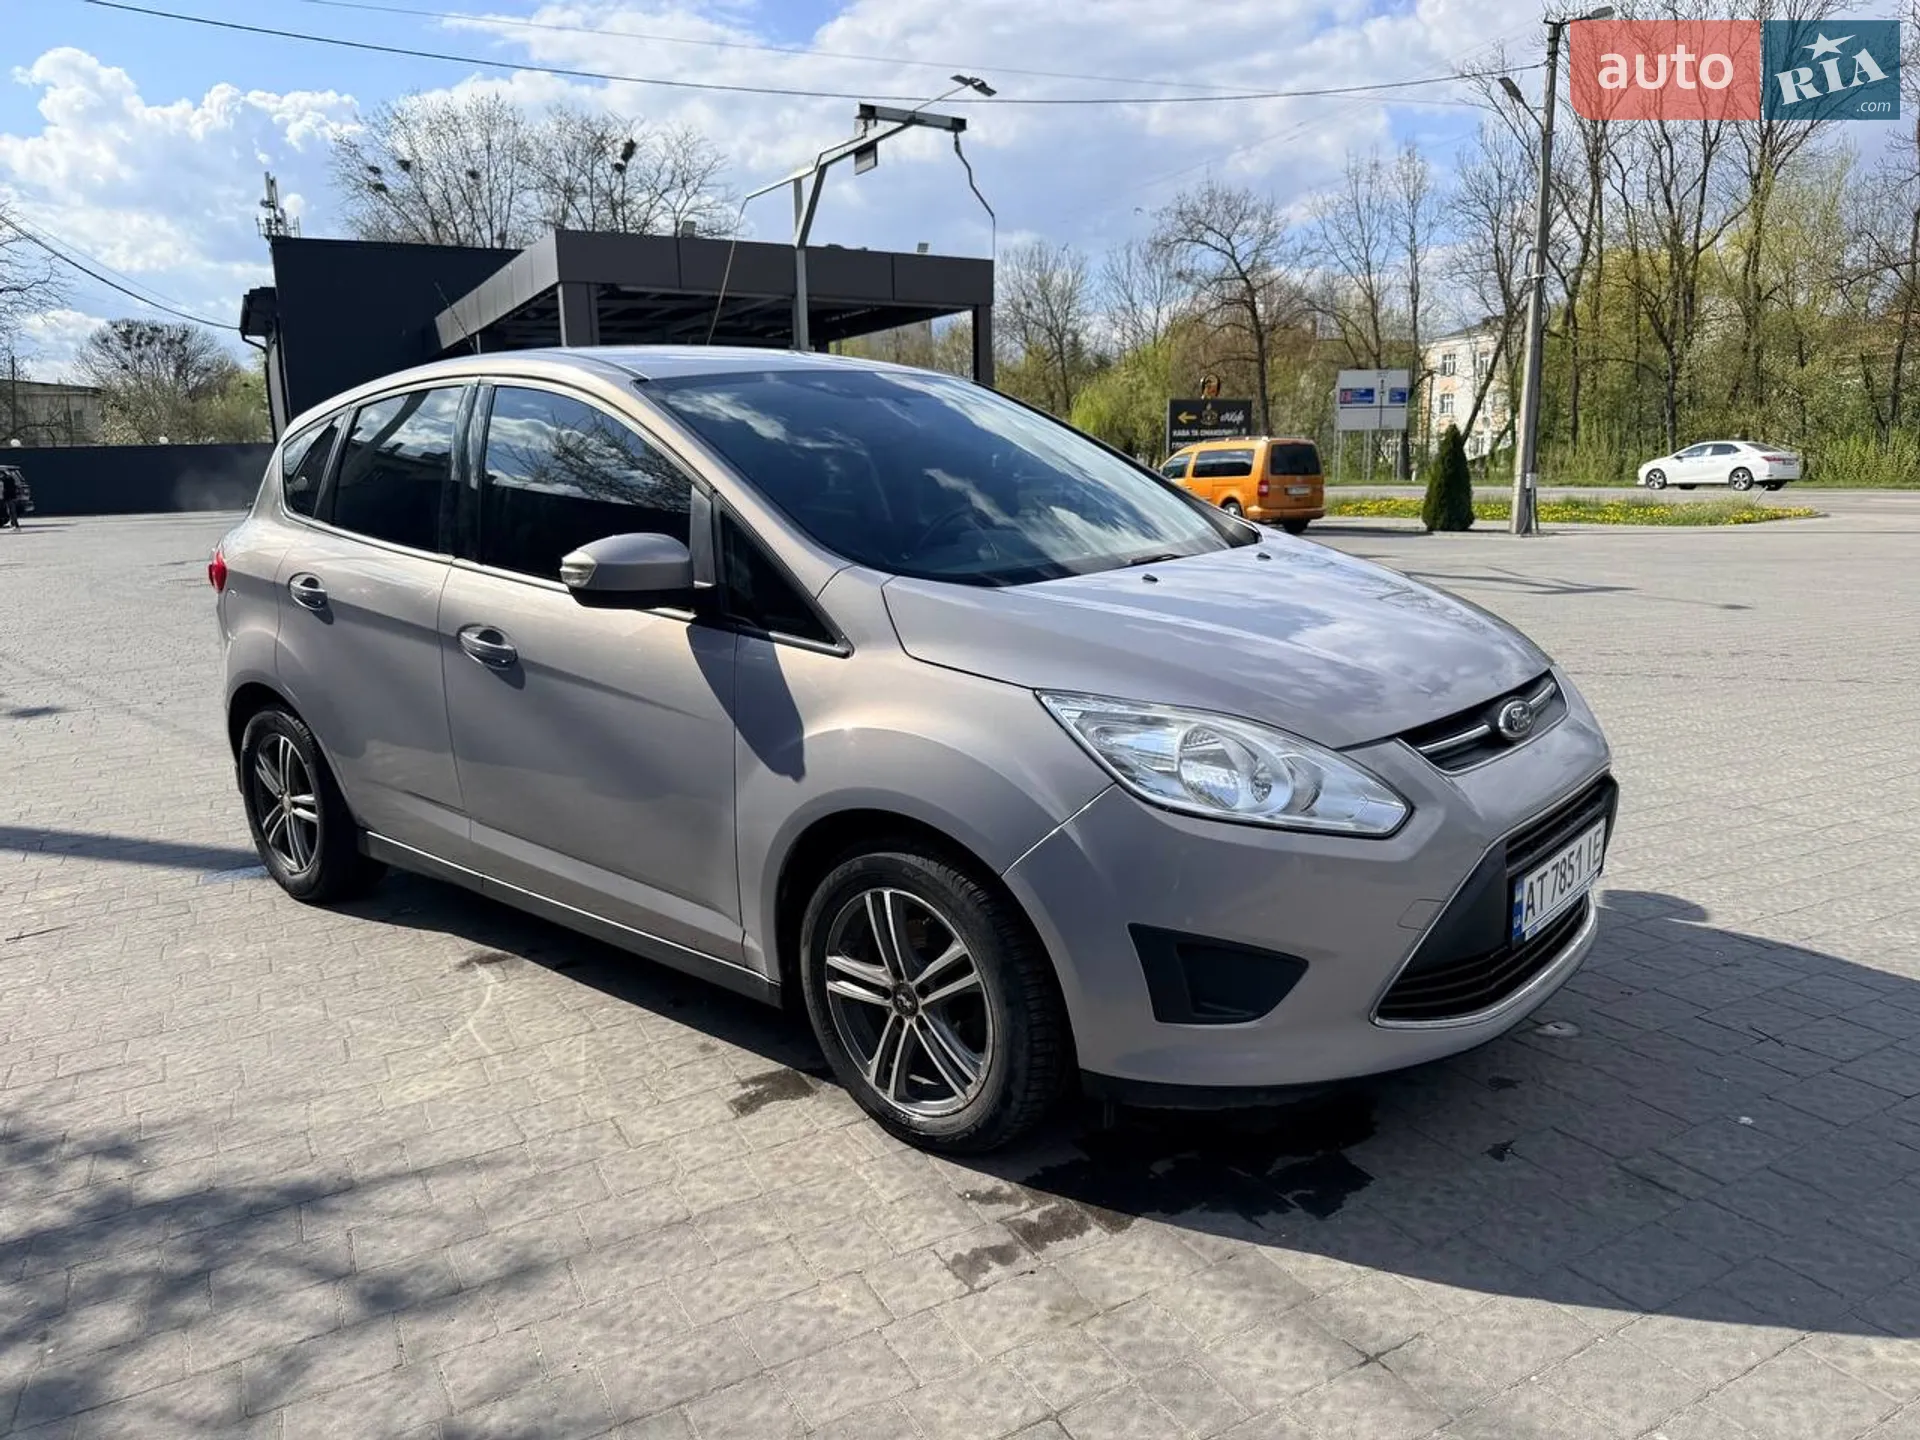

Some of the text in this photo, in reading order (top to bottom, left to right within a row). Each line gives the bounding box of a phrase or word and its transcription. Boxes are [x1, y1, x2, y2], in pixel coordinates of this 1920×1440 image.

[1524, 871, 1549, 922] AT
[1550, 844, 1583, 903] 7851
[1587, 829, 1602, 872] IE
